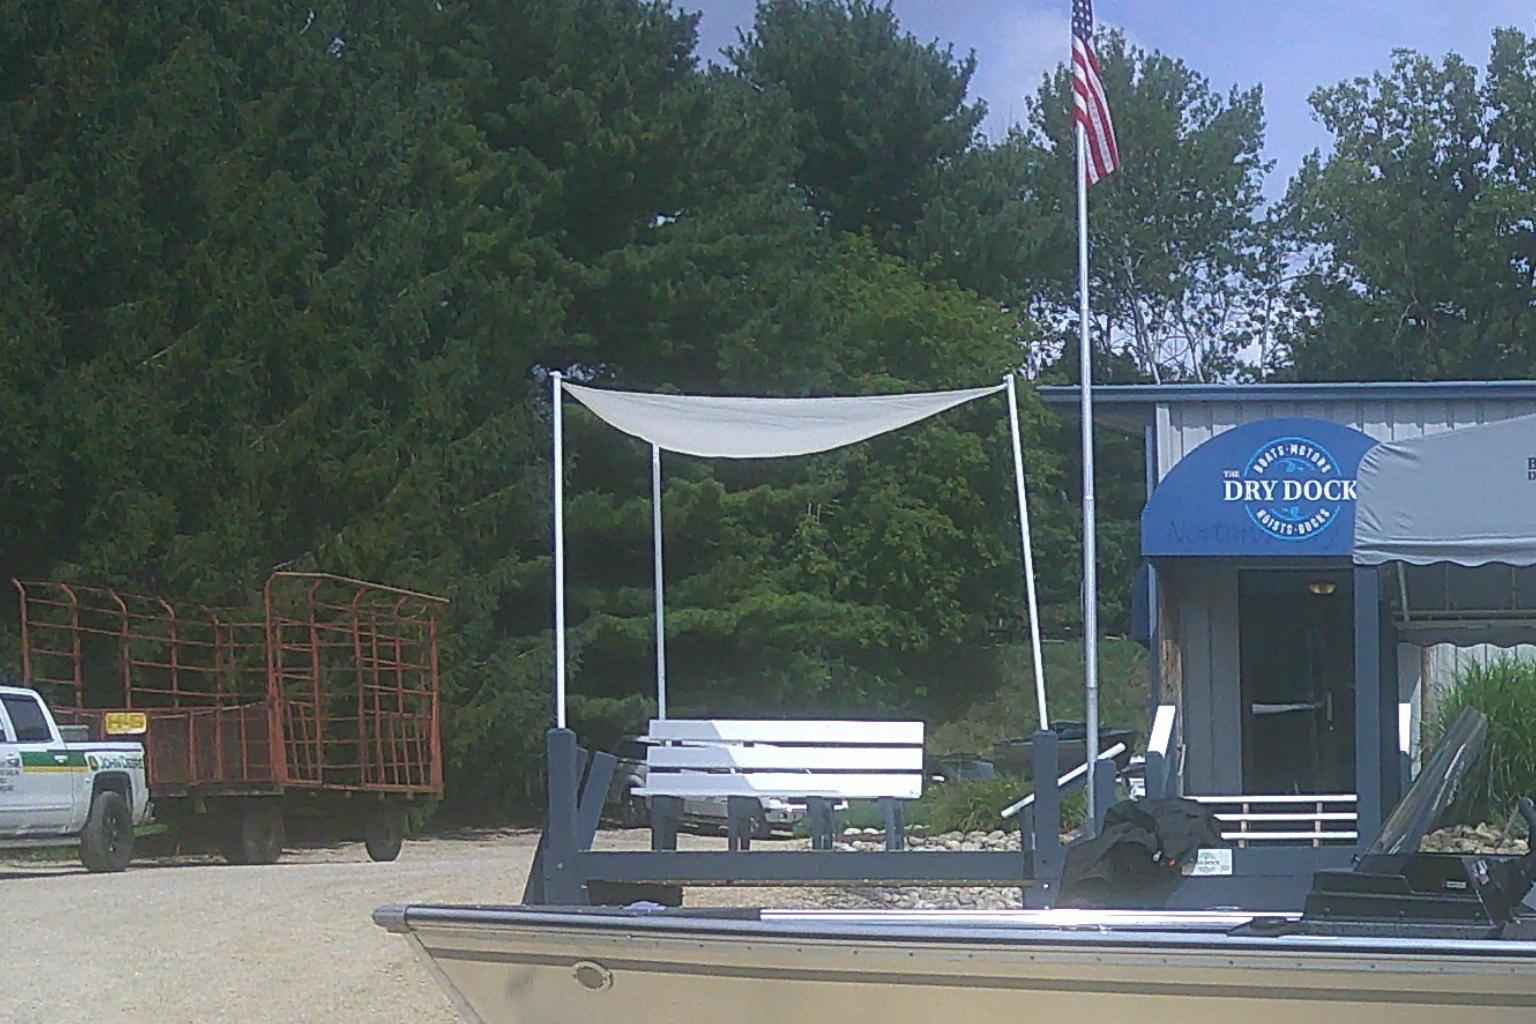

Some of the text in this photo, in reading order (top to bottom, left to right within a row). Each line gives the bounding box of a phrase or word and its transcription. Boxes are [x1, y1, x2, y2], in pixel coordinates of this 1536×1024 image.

[1253, 443, 1332, 474] BOATS MOTORS
[1223, 470, 1240, 478] THE
[1223, 480, 1358, 501] DRY DOCK
